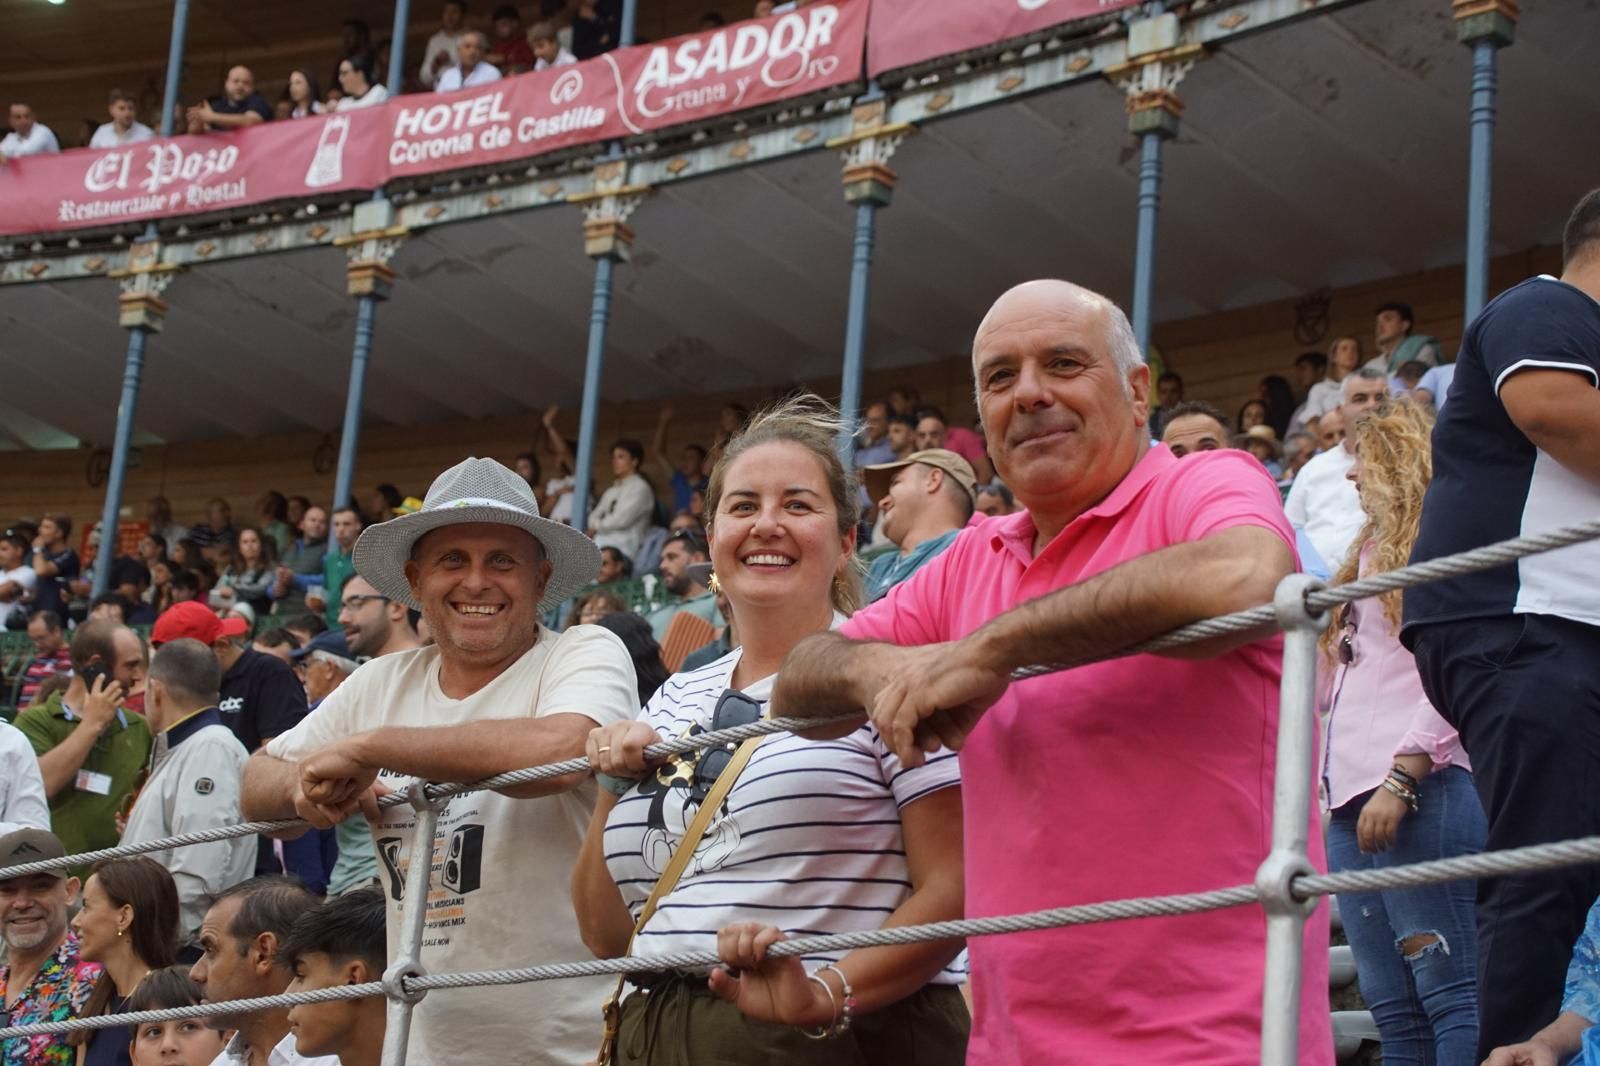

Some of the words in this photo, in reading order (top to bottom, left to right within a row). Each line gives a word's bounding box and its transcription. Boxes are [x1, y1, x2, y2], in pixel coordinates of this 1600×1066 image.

[634, 4, 839, 94] ASADOR
[394, 92, 511, 138] HOTEL
[636, 82, 727, 118] Grana
[733, 75, 752, 106] y
[389, 131, 474, 165] Corona
[479, 124, 512, 150] de
[517, 105, 606, 143] Castilla
[84, 150, 133, 193] El
[138, 143, 239, 194] Pozo
[451, 916, 466, 925] MIX
